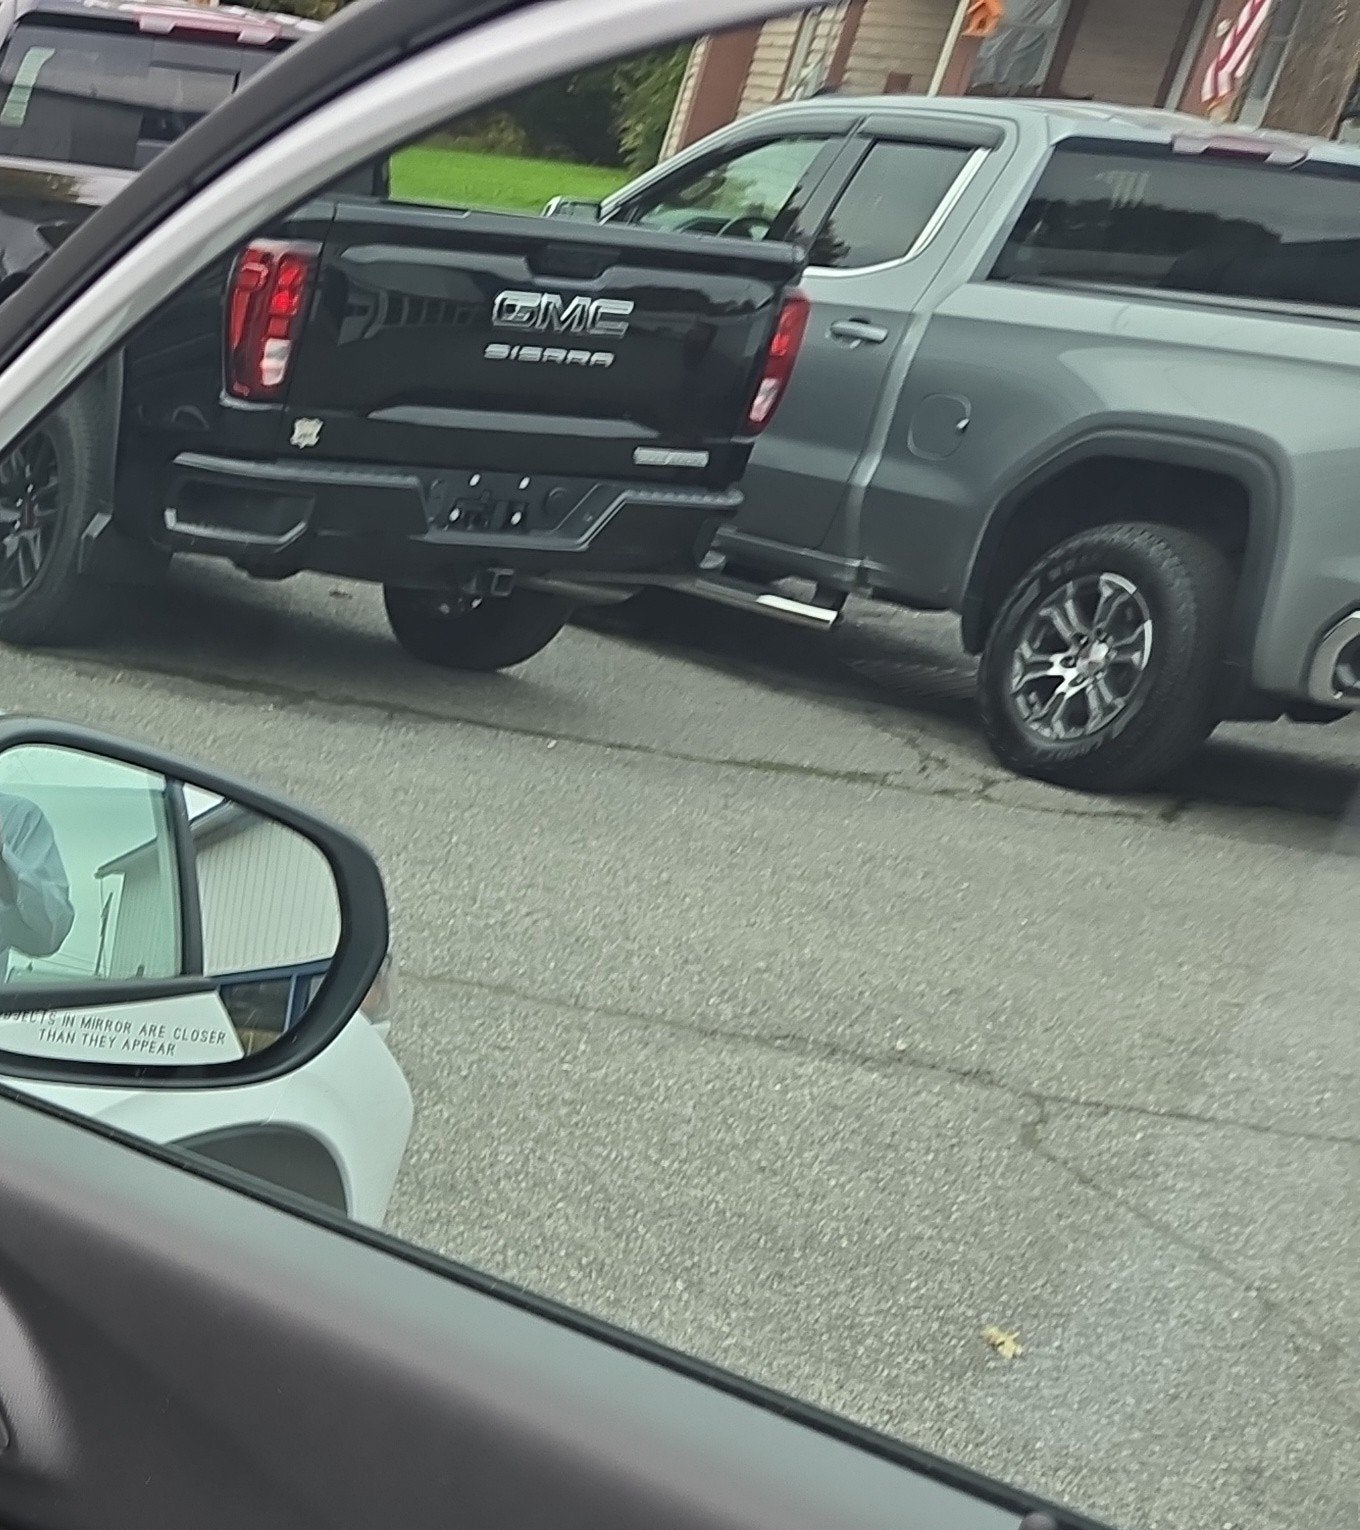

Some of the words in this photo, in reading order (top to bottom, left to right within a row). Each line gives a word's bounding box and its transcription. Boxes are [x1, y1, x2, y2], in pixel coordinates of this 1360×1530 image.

[492, 290, 635, 338] GMC
[483, 343, 616, 368] SIERRA
[38, 1028, 76, 1044] THAN
[80, 1033, 117, 1049] THEY
[121, 1038, 176, 1057] APPEAR
[61, 1013, 76, 1028] IN
[80, 1016, 132, 1034] MIRROR
[138, 1024, 166, 1040] ARE
[173, 1028, 227, 1046] CLOSER
